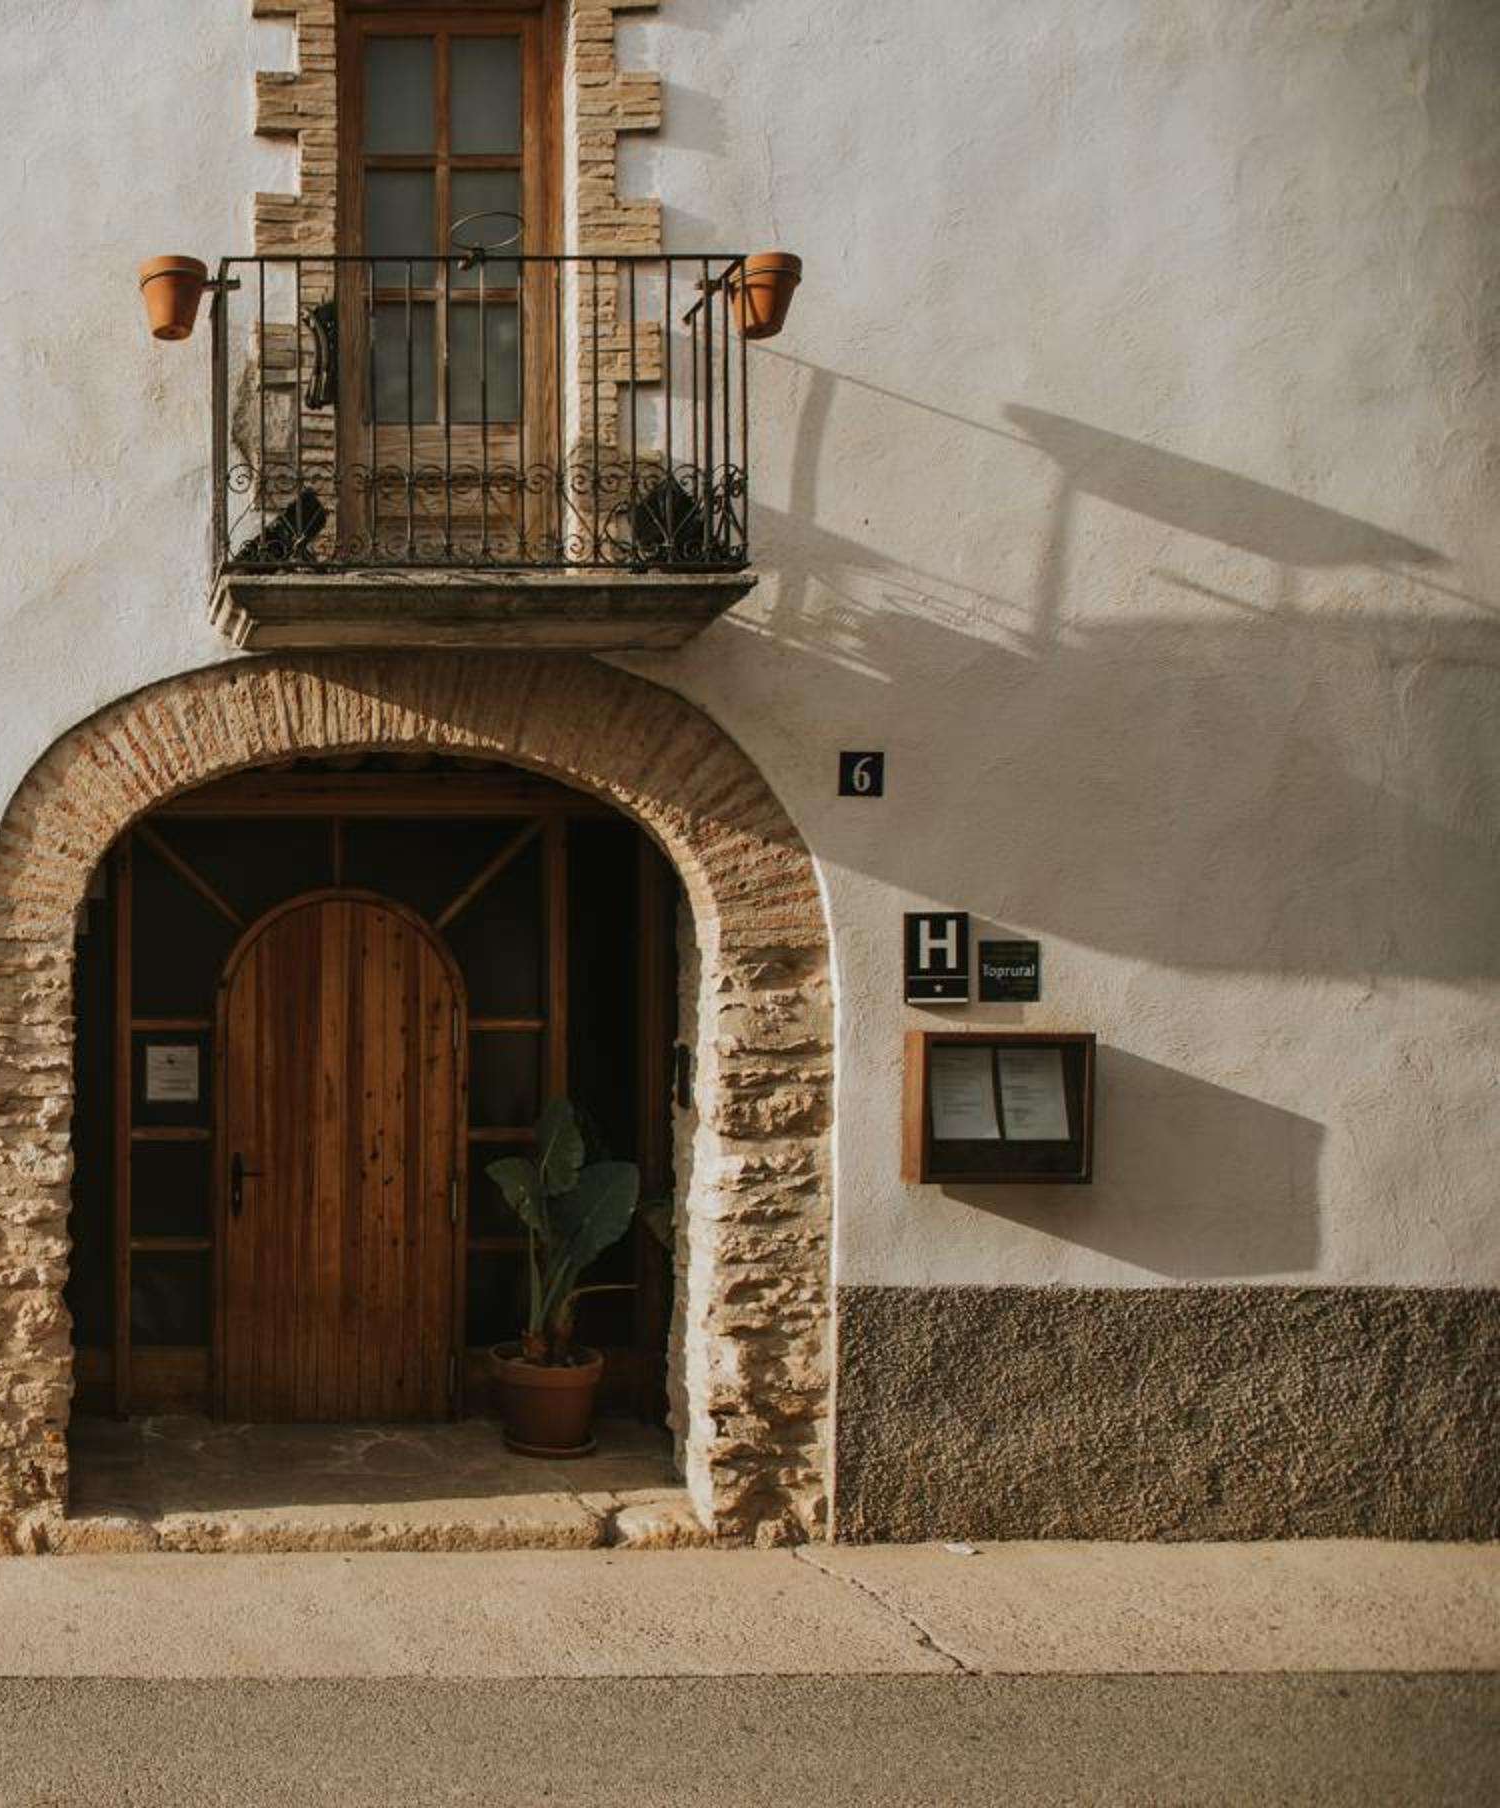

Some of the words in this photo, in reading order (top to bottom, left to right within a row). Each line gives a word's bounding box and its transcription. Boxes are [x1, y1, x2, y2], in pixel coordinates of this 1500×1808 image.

[852, 755, 875, 793] 6
[919, 919, 957, 969] H
[982, 963, 1036, 979] Toprural
